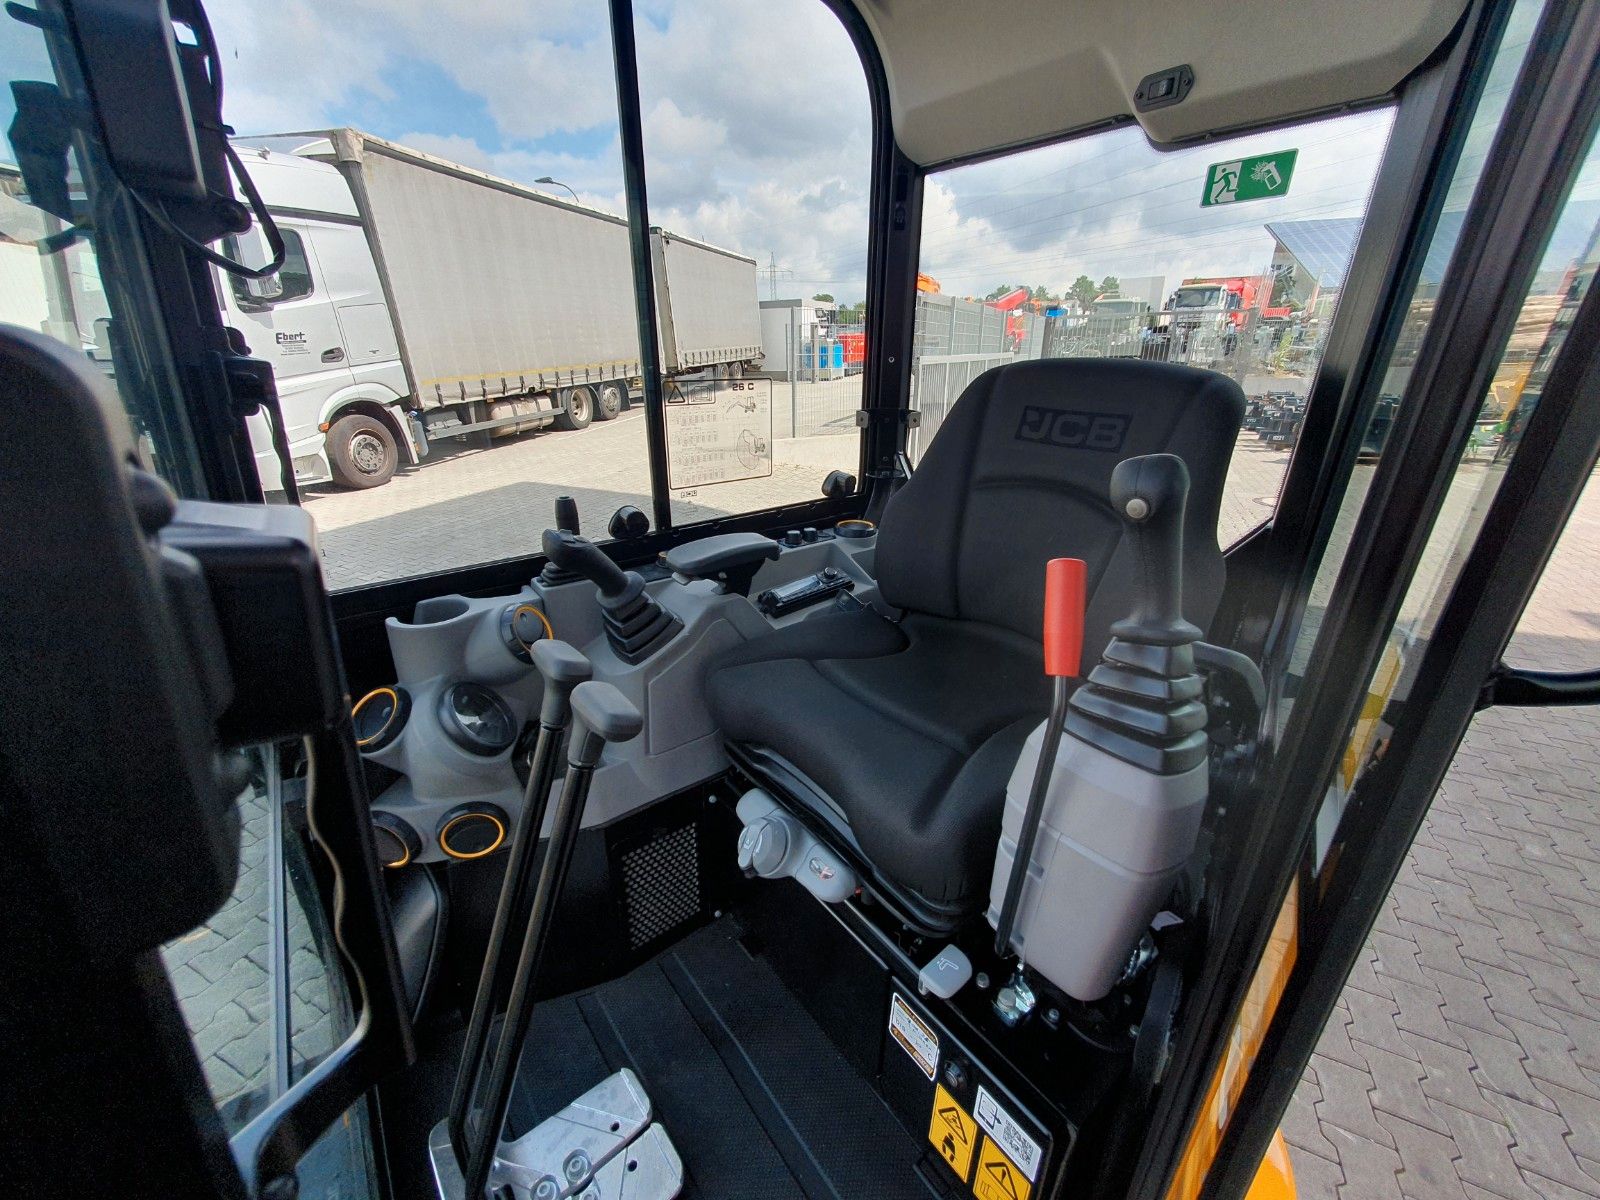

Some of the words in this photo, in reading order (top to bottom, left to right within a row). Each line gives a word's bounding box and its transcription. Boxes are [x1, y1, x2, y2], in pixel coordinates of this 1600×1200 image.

[275, 332, 306, 344] Ebert
[732, 383, 745, 391] 26
[747, 382, 754, 390] C
[1020, 409, 1126, 449] JCB
